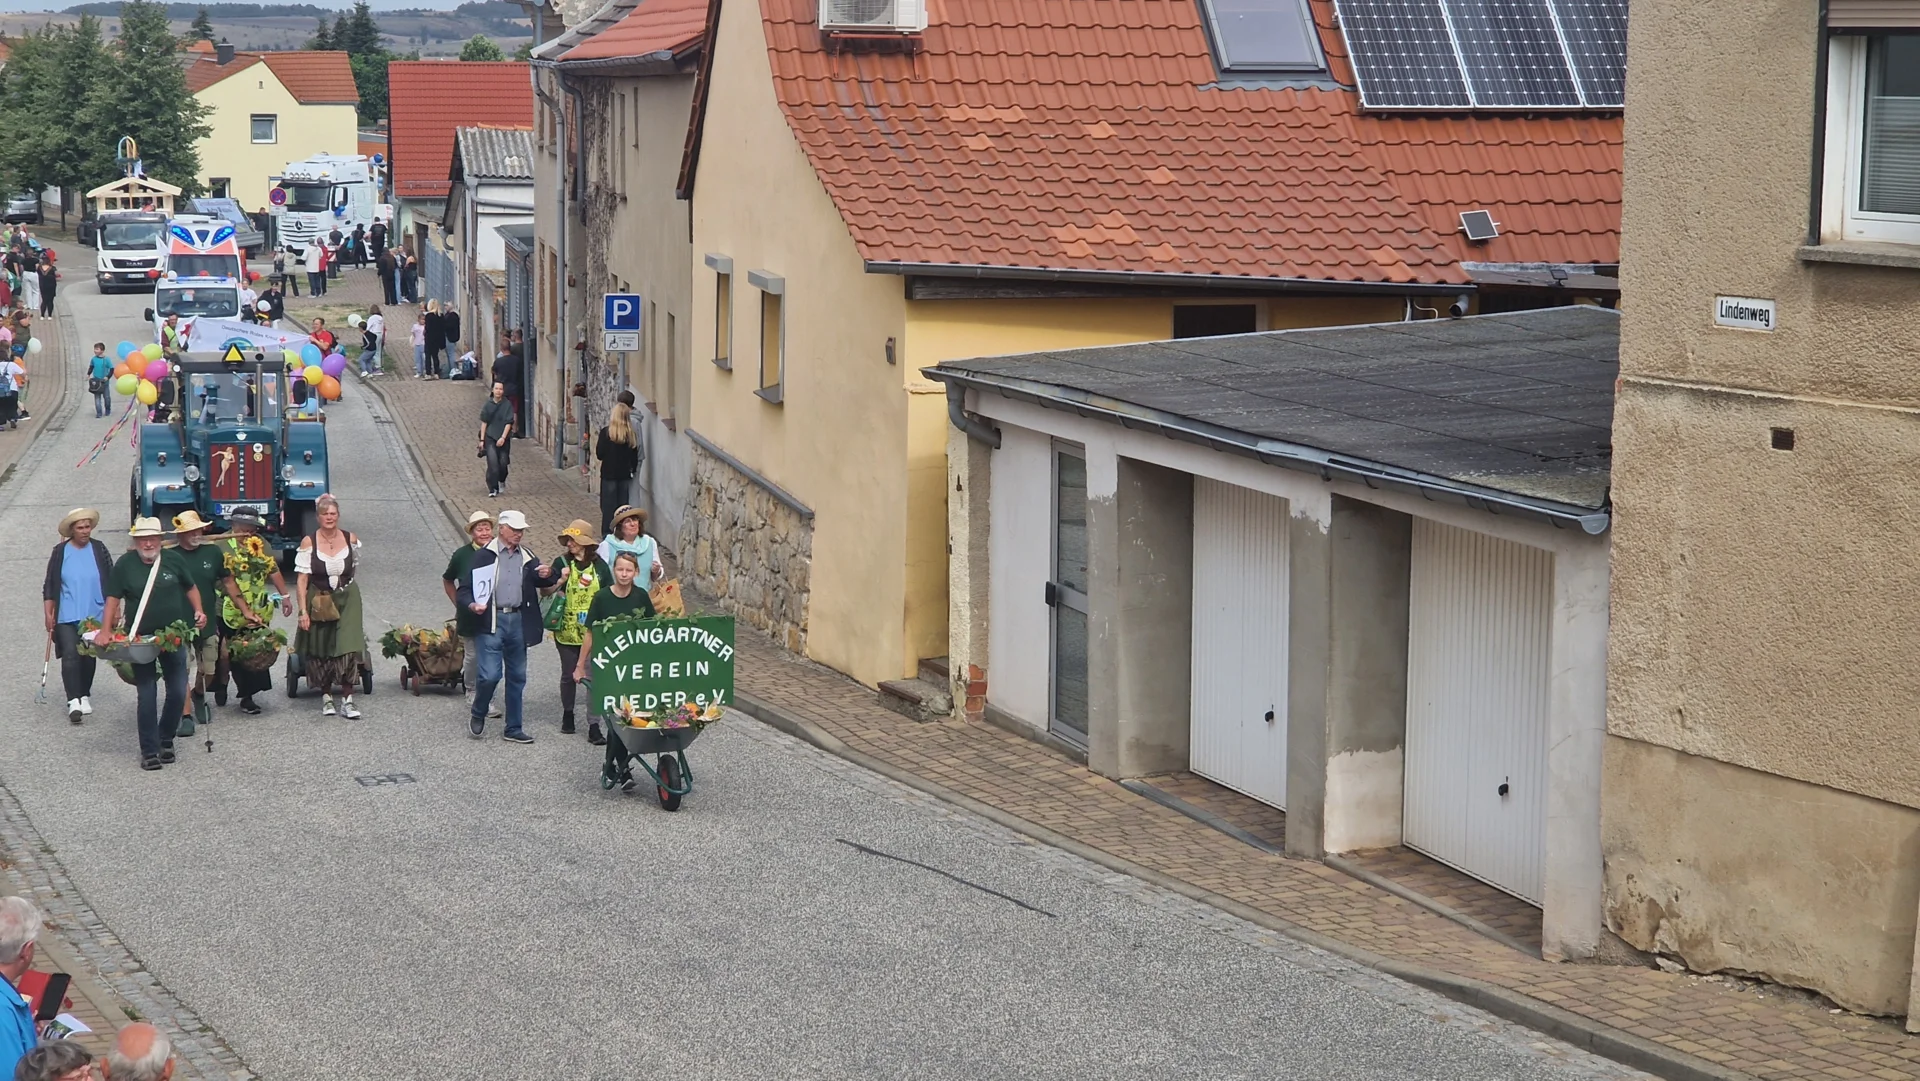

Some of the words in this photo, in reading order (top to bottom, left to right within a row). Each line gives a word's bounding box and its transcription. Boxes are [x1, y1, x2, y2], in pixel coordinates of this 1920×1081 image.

[613, 299, 632, 326] P
[1720, 299, 1770, 327] Lindenweg
[221, 324, 249, 334] Deutsches
[477, 577, 492, 599] 21
[592, 624, 734, 670] KLEINGÄRTNER
[614, 660, 709, 682] VEREIN
[603, 691, 687, 711] RIEDER
